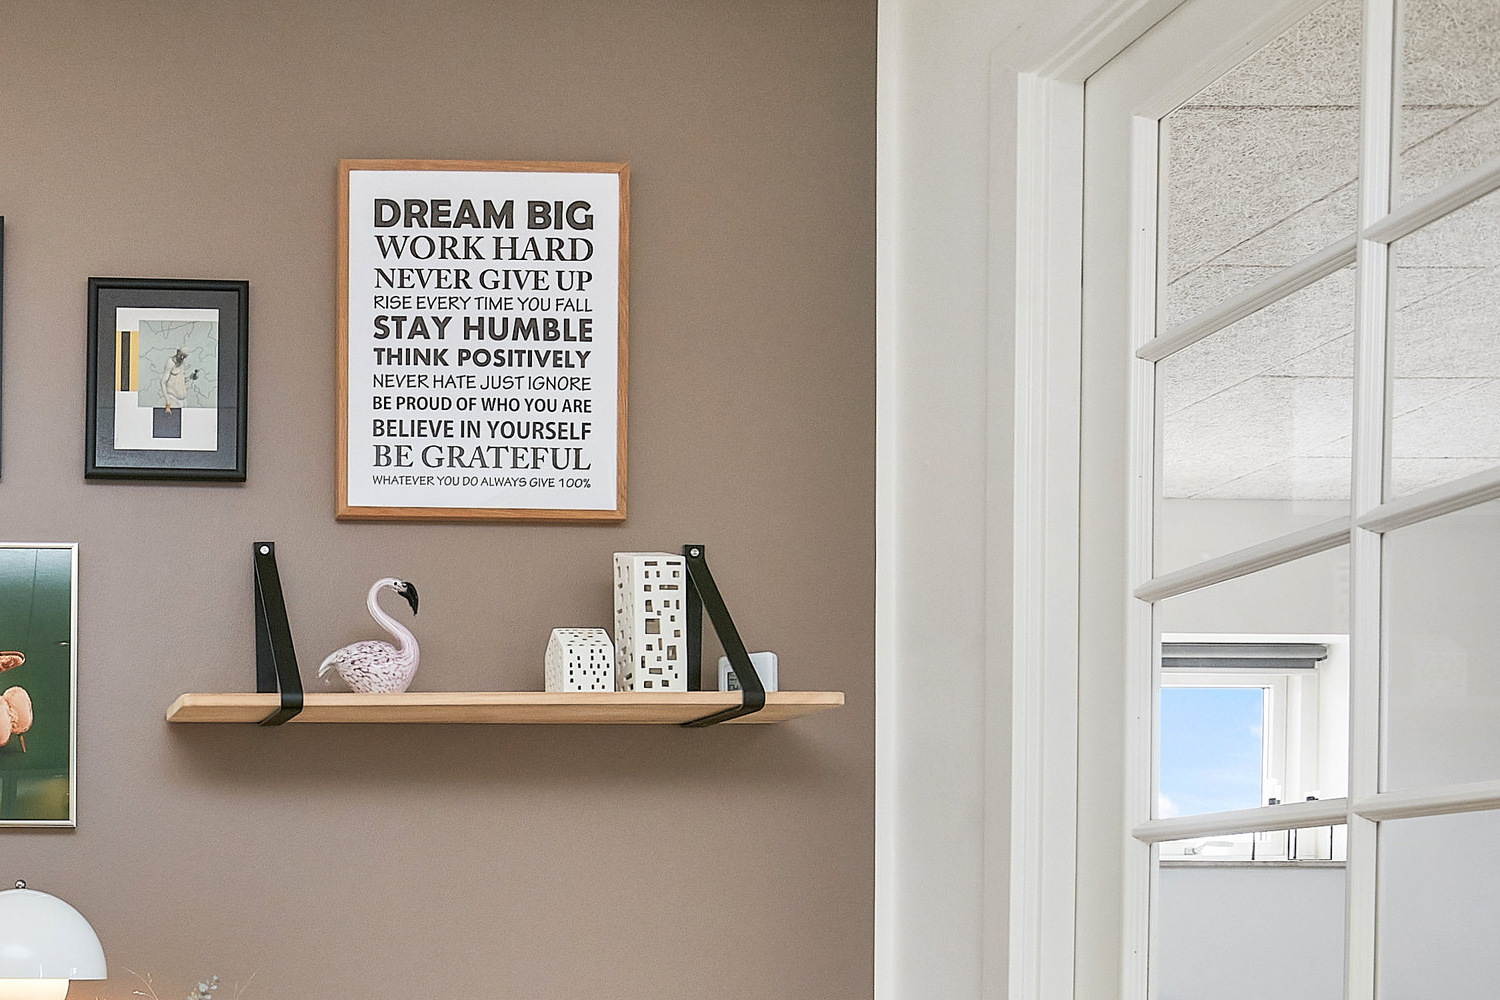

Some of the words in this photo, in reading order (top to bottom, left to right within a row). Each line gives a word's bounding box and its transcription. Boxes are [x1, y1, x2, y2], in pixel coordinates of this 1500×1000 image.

[373, 198, 515, 230] DREAM
[526, 200, 594, 231] BIG
[373, 234, 486, 261] WORK
[491, 235, 594, 262] HARD
[373, 267, 474, 290] NEVER
[478, 268, 550, 291] GIVE
[555, 270, 593, 292] UP
[373, 295, 413, 310] RISE
[416, 295, 472, 311] EVERY
[473, 296, 514, 311] TIME
[516, 297, 551, 312] YOU
[555, 297, 593, 313] FALL
[373, 314, 453, 340] STAY
[463, 316, 593, 343] HUMBLE
[373, 347, 450, 367] THINK
[457, 348, 592, 369] POSITIVELY
[373, 373, 430, 389] NEVER
[433, 374, 477, 390] HATE
[479, 375, 525, 391] JUST
[528, 375, 592, 392] IGNORE
[372, 395, 392, 410] BE
[396, 395, 453, 411] PROUD
[456, 396, 477, 412] OF
[480, 397, 521, 412] WHO
[523, 398, 558, 413] YOU
[561, 398, 592, 414] ARE
[372, 418, 455, 439] BELIEVE
[460, 420, 481, 439] IN
[486, 420, 592, 441] YOURSELF
[372, 444, 414, 468] BE
[421, 444, 592, 471] GRATEFUL
[372, 474, 435, 486] WHATEVER
[436, 475, 460, 487] YOU
[462, 476, 479, 487] DO
[480, 476, 528, 488] ALWAYS
[529, 477, 556, 488] GIVE
[558, 477, 592, 489] 100%
